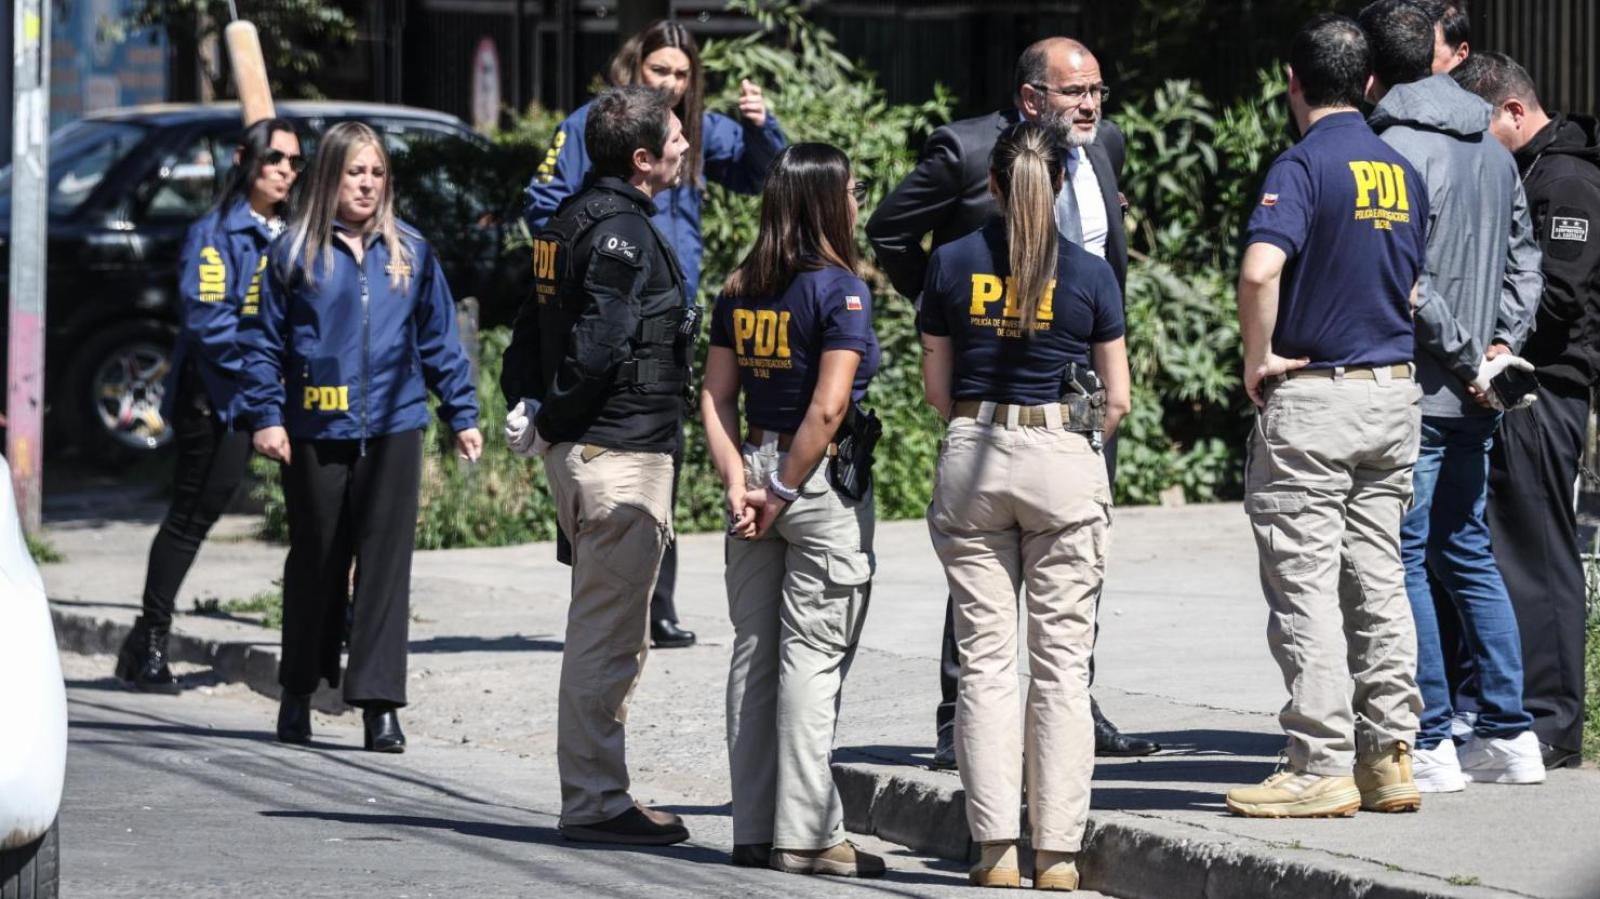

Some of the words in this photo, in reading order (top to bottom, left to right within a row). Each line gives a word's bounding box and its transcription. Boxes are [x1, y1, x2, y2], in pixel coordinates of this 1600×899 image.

[1348, 160, 1410, 212] PDI
[733, 308, 791, 358] PDI
[303, 385, 349, 411] PDI
